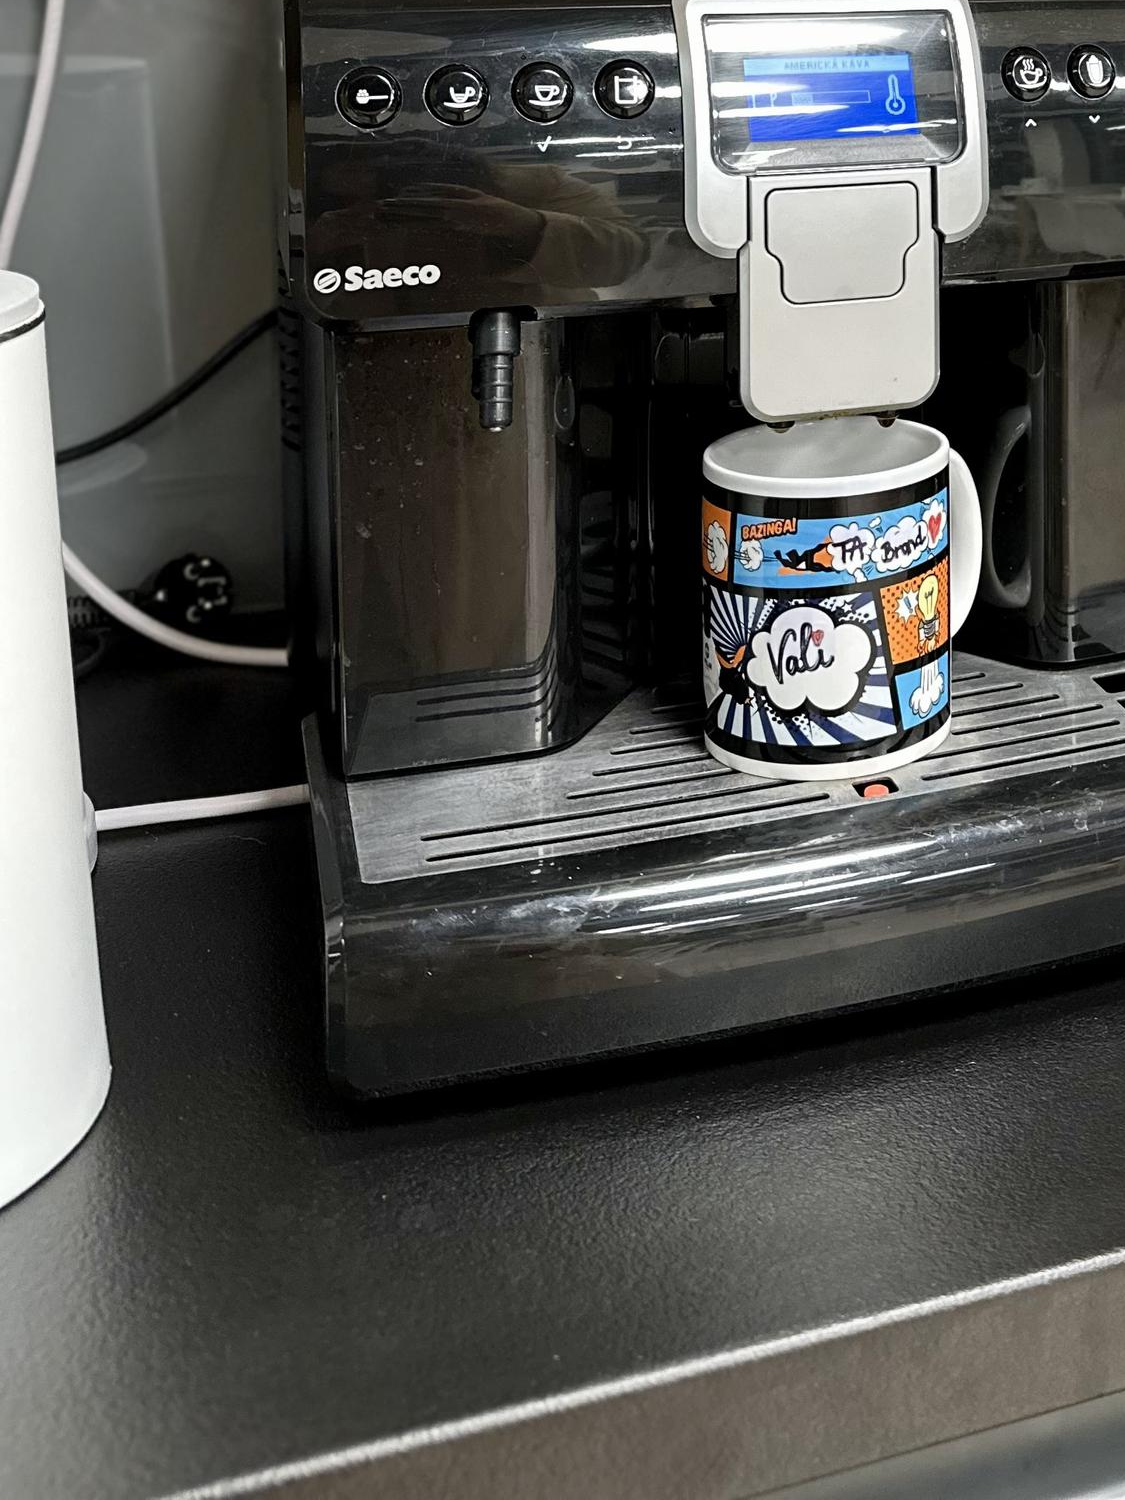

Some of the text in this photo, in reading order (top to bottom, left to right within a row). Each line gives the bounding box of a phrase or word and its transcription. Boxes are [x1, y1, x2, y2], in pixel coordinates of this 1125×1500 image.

[344, 264, 441, 291] Saeco
[741, 517, 797, 541] BAZINGA!
[832, 535, 868, 564] TA
[767, 622, 835, 685] Vali
